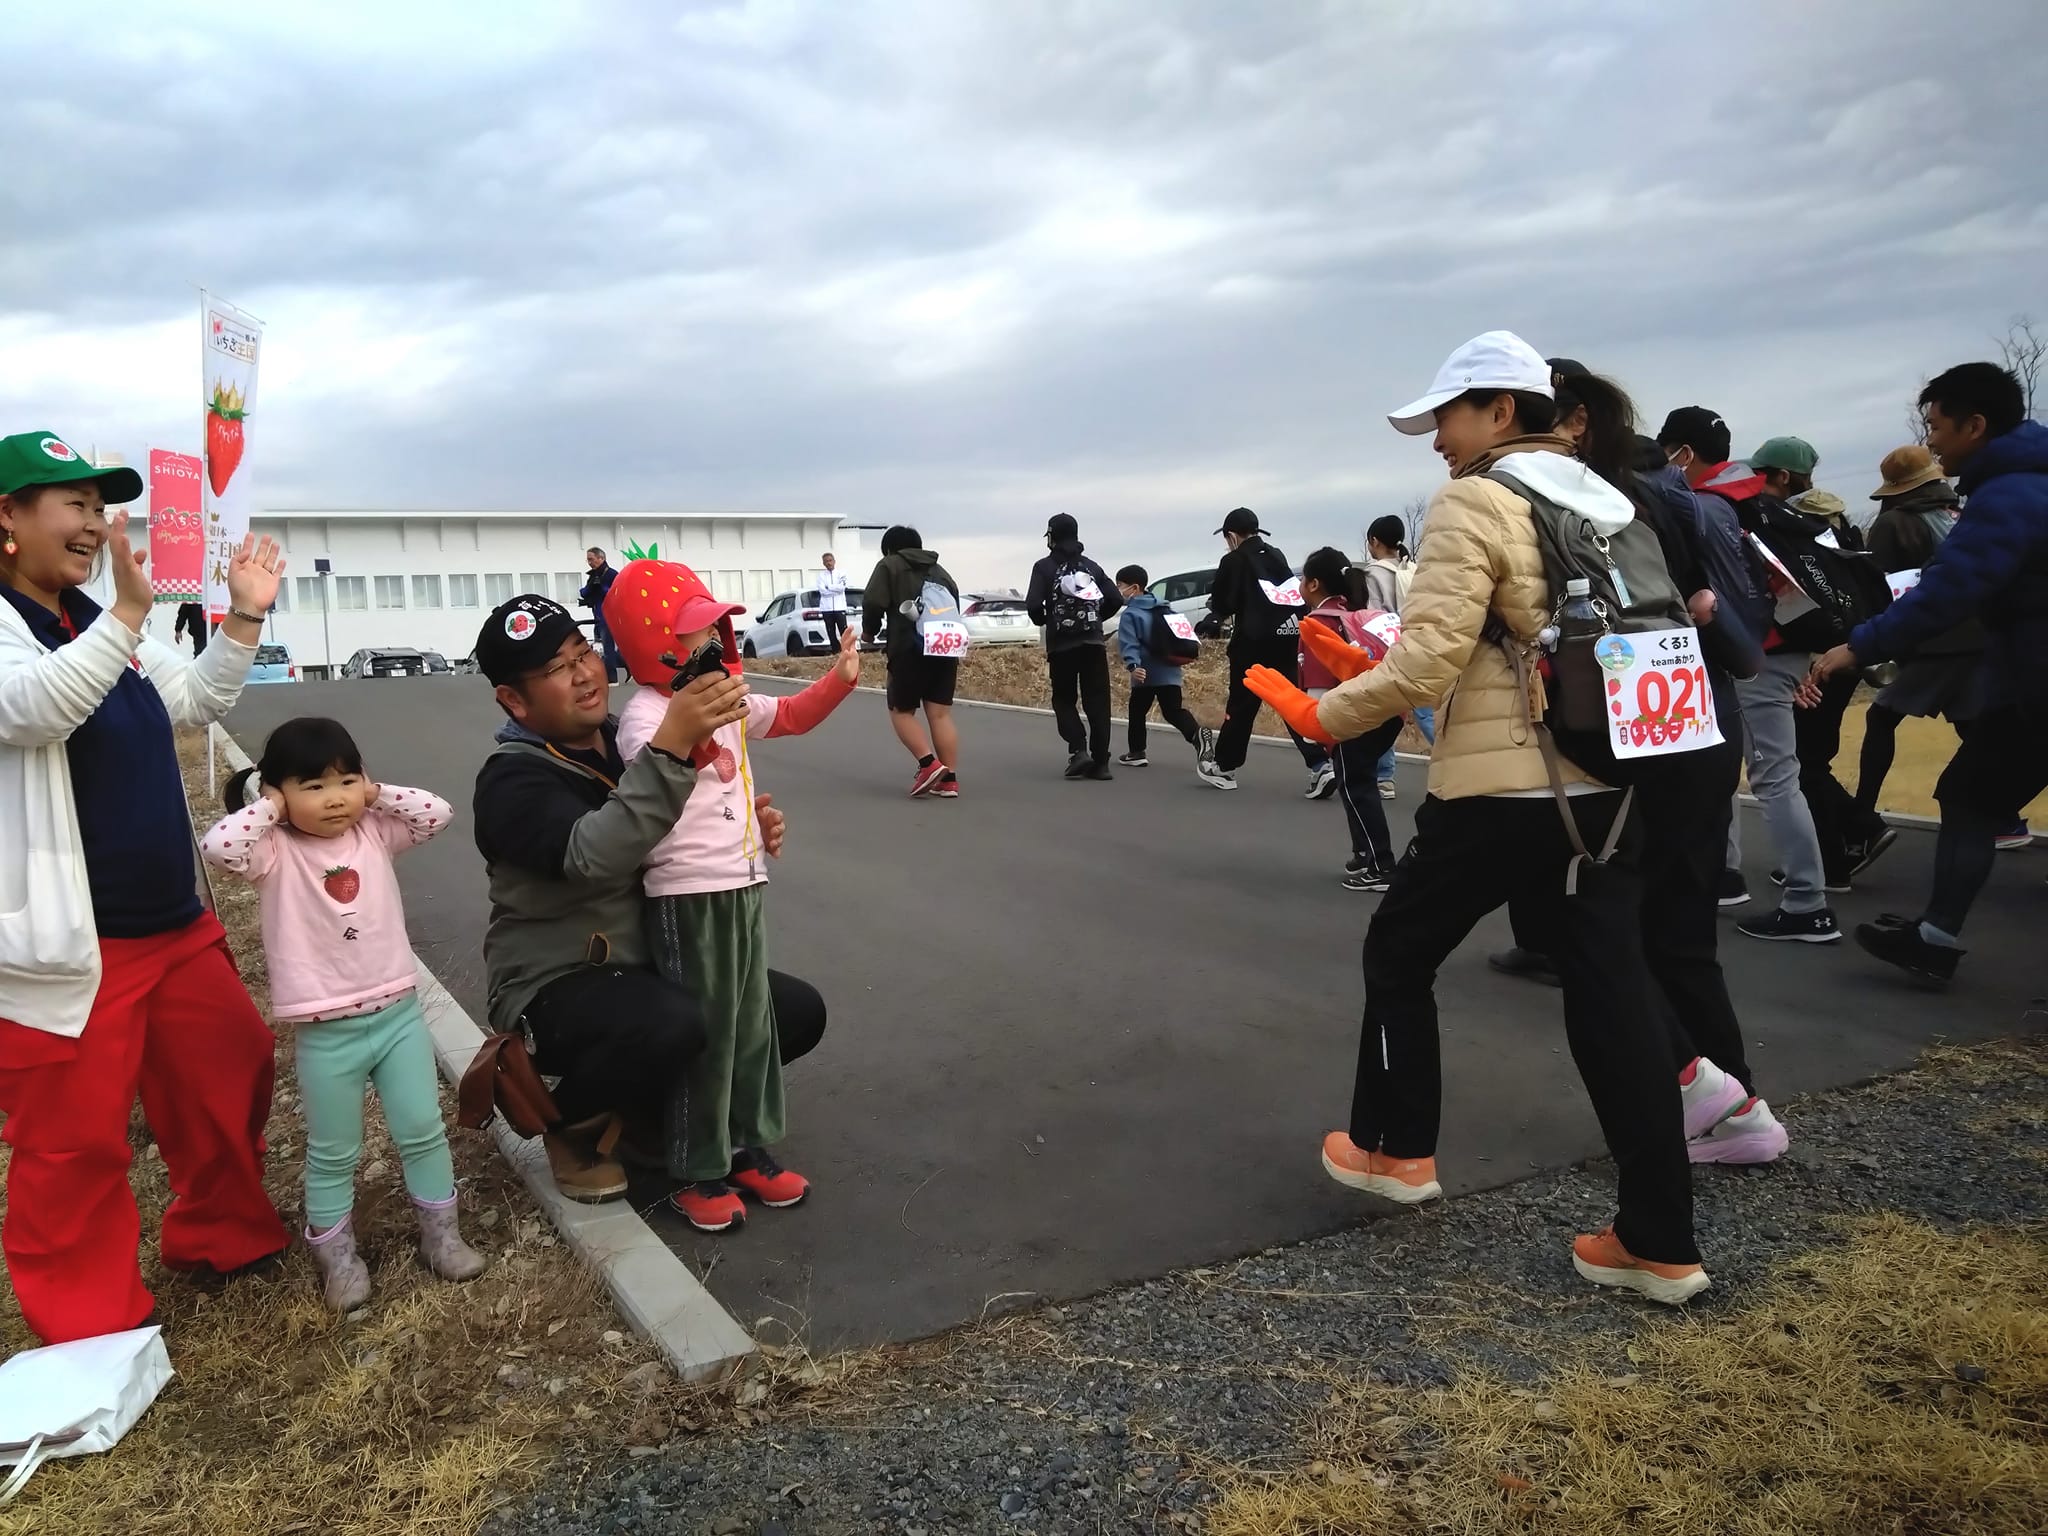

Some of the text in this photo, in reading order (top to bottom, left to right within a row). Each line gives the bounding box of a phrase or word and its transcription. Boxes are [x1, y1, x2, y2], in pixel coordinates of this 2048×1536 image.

[154, 466, 200, 480] SHIOYA
[1276, 627, 1299, 635] adida
[933, 632, 962, 649] 263
[1651, 654, 1695, 667] teamあかり
[1636, 665, 1707, 720] 021
[1632, 721, 1683, 742] いちご
[340, 911, 360, 941] 一会
